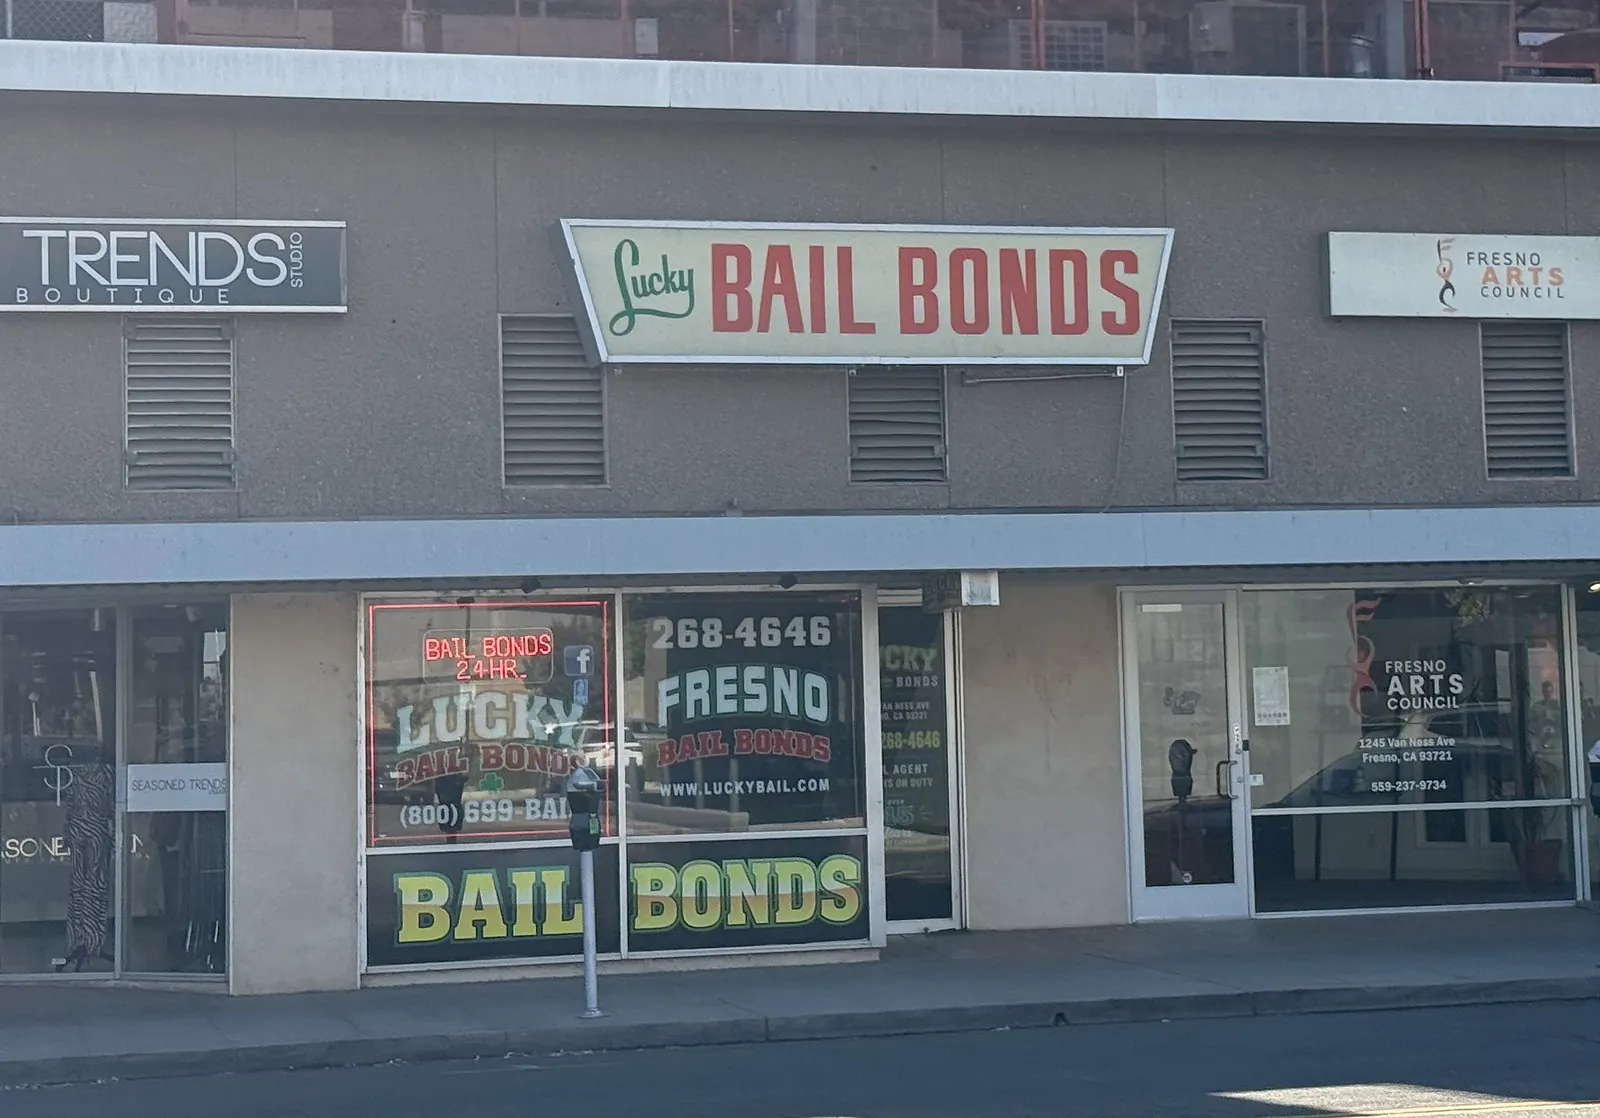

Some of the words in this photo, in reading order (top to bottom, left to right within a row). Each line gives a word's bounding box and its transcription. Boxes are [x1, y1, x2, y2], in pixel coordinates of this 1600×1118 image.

[23, 230, 287, 287] TRENDS
[290, 231, 303, 288] STUDIO
[1467, 252, 1541, 266] FRESNO
[1482, 267, 1564, 286] ARTS
[16, 288, 229, 303] BOUTIQUE
[609, 239, 695, 336] Lucky
[711, 243, 876, 333] BAIL
[899, 246, 1140, 335] BONDS
[1480, 286, 1564, 298] COUNCIL
[652, 616, 831, 649] 268-4646
[425, 637, 476, 661] BAIL
[483, 634, 552, 657] BONDS
[1385, 659, 1446, 673] FRESNO
[895, 675, 938, 688] BONDS
[1387, 674, 1464, 695] ARTS
[658, 665, 829, 728] FRESNO
[1387, 696, 1460, 711] COUNCIL
[396, 689, 585, 753] LUCKY
[657, 730, 729, 767] BAIL
[734, 728, 831, 762] BONDS
[1359, 738, 1385, 748] 1245
[1387, 738, 1407, 748] Van
[1409, 738, 1434, 748] Ness
[1436, 737, 1455, 747] Ave
[1362, 753, 1401, 764] Fresno,
[1403, 752, 1417, 762] CA
[1419, 751, 1453, 762] 93721
[396, 745, 470, 791] BAIL
[893, 763, 929, 774] AGENT
[131, 779, 186, 791] SEASONED
[189, 778, 226, 790] TRENDS
[660, 778, 830, 797] WWW.LUCKYBAIL.COM
[910, 777, 934, 787] DUTY
[1371, 780, 1447, 792] 559-237-9734
[400, 801, 459, 828] (800)
[464, 796, 572, 824] 699-BAI
[1, 836, 71, 858] SONE
[395, 866, 583, 946] BAIL
[630, 854, 862, 933] BONDS
